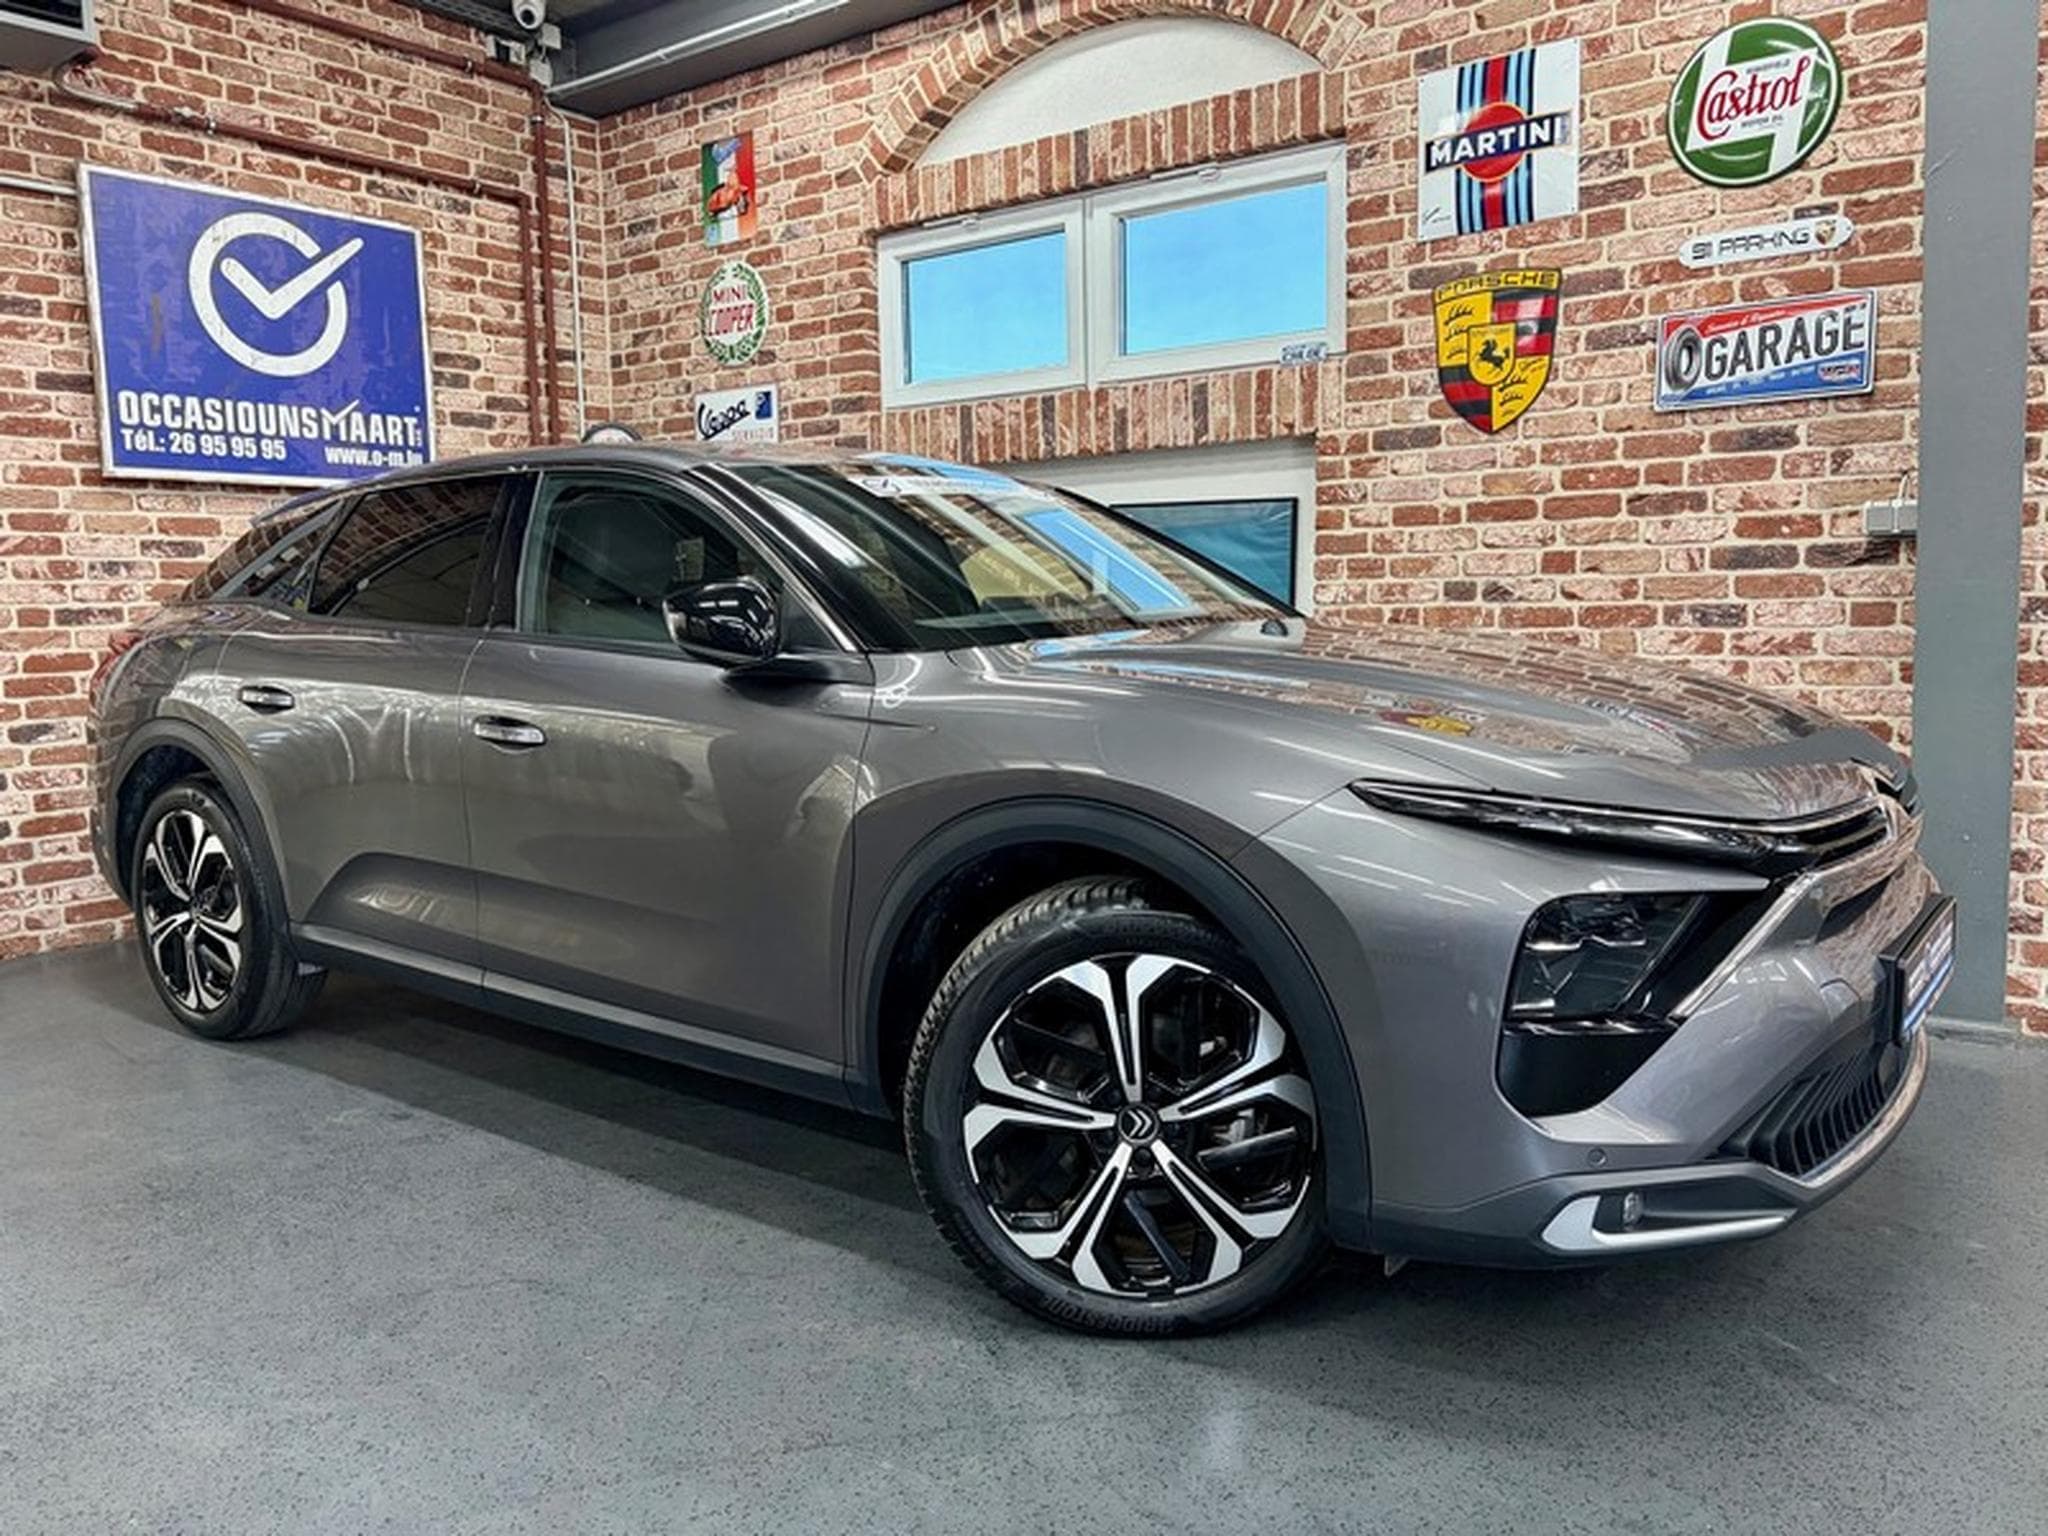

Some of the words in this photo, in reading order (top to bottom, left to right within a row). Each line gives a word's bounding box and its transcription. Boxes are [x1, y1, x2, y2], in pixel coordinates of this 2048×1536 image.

[1697, 56, 1810, 141] Castrol
[1430, 117, 1562, 167] MARTINI
[1719, 227, 1811, 255] PARKING
[712, 284, 747, 303] MINI
[1437, 272, 1556, 301] PORSCHE
[708, 303, 754, 336] COOPER
[1704, 303, 1867, 381] GARAGE
[698, 400, 750, 441] Vespa
[169, 432, 196, 454] 26
[200, 434, 227, 457] 95
[231, 436, 257, 459] 95
[261, 439, 287, 461] 95
